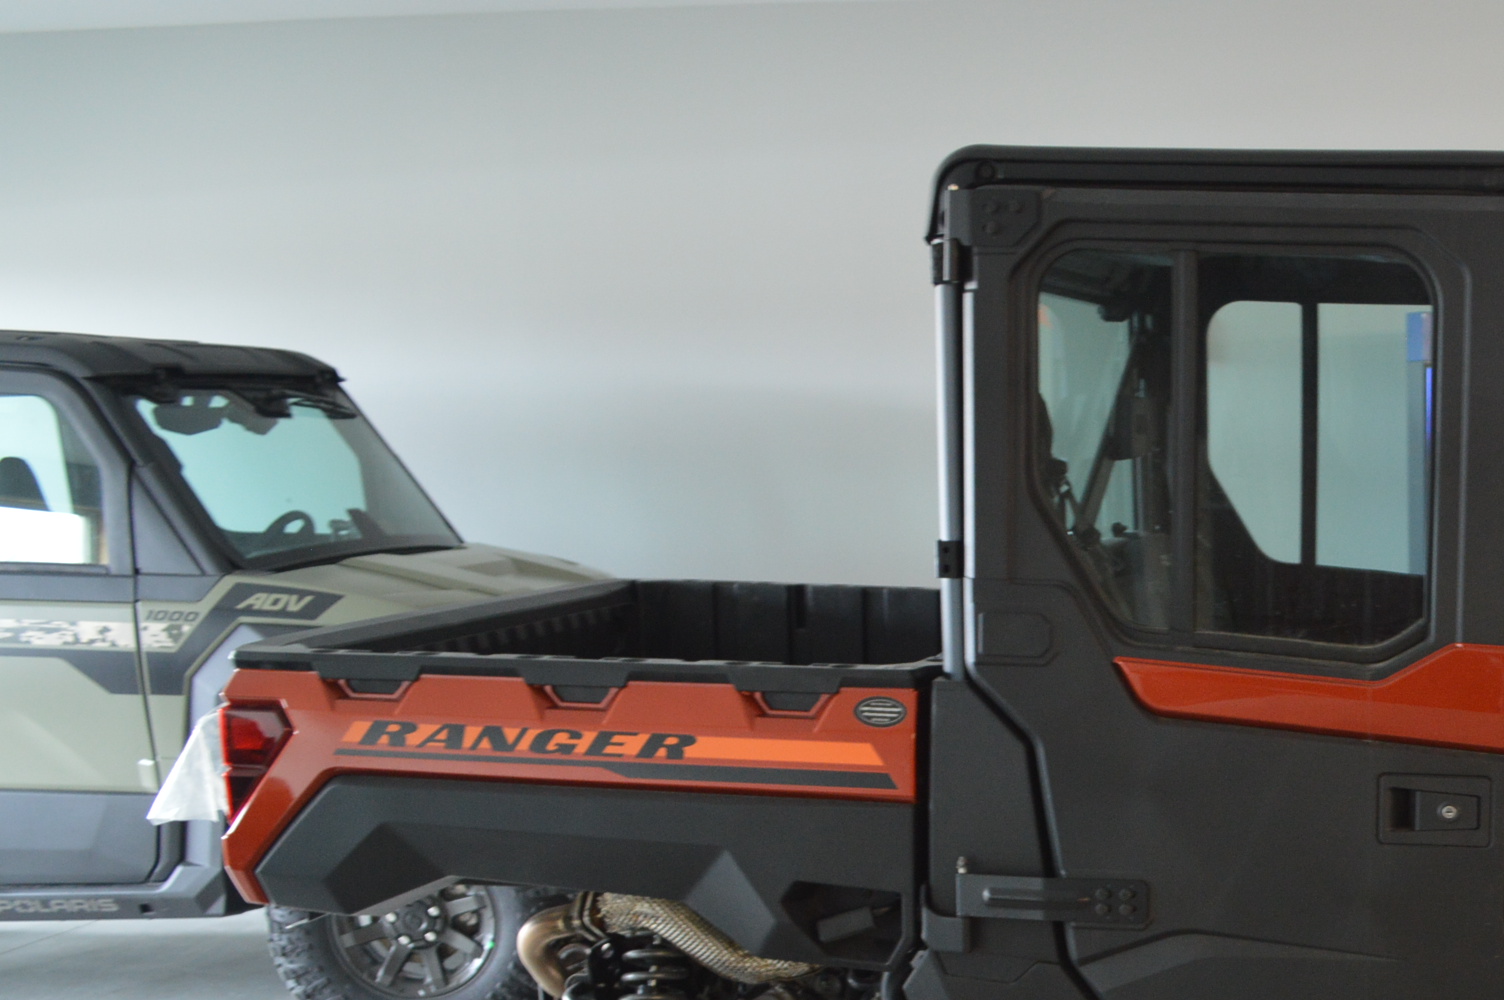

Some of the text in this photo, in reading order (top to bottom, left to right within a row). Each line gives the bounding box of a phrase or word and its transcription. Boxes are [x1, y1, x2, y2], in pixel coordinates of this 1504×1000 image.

[235, 592, 316, 612] ADV
[146, 609, 200, 621] 1000
[358, 720, 697, 760] RANGER
